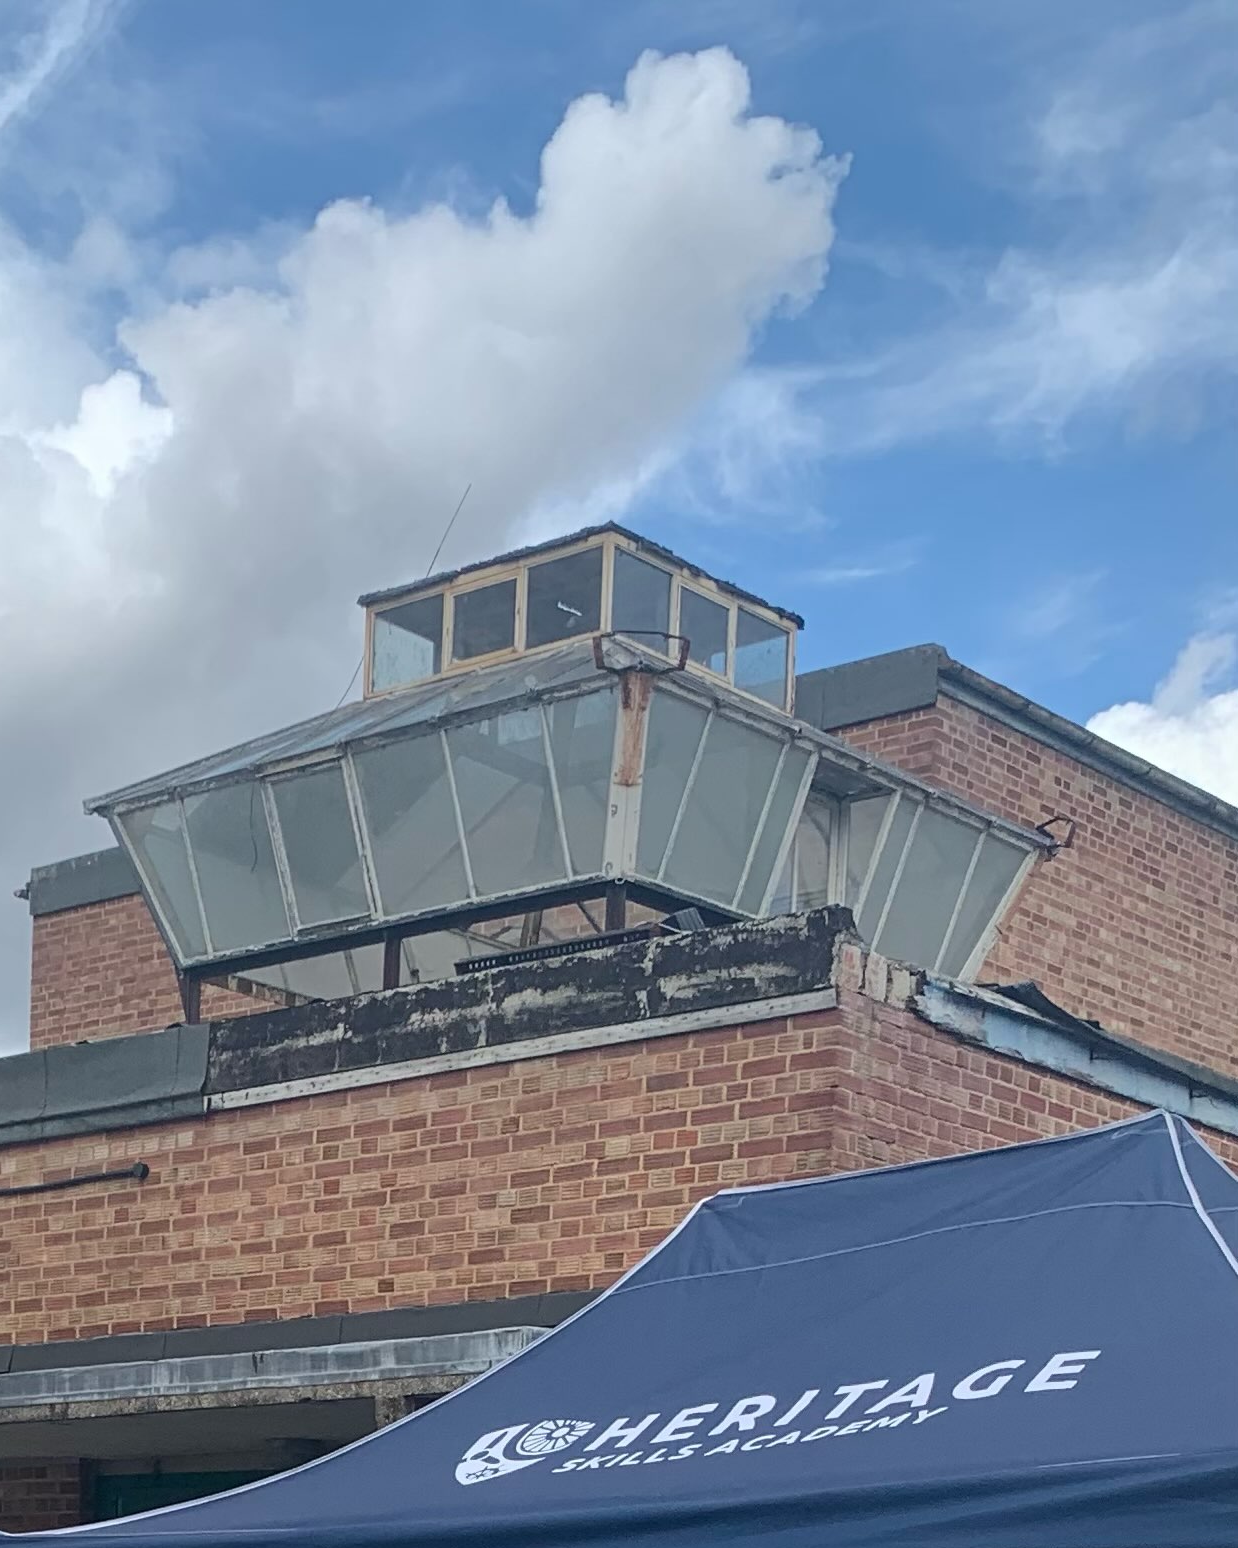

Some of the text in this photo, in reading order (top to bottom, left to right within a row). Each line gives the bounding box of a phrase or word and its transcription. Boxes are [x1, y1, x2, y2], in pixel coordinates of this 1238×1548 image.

[551, 1407, 949, 1474] SKILLS ACADEMY
[583, 1350, 1101, 1452] HERITAGE
